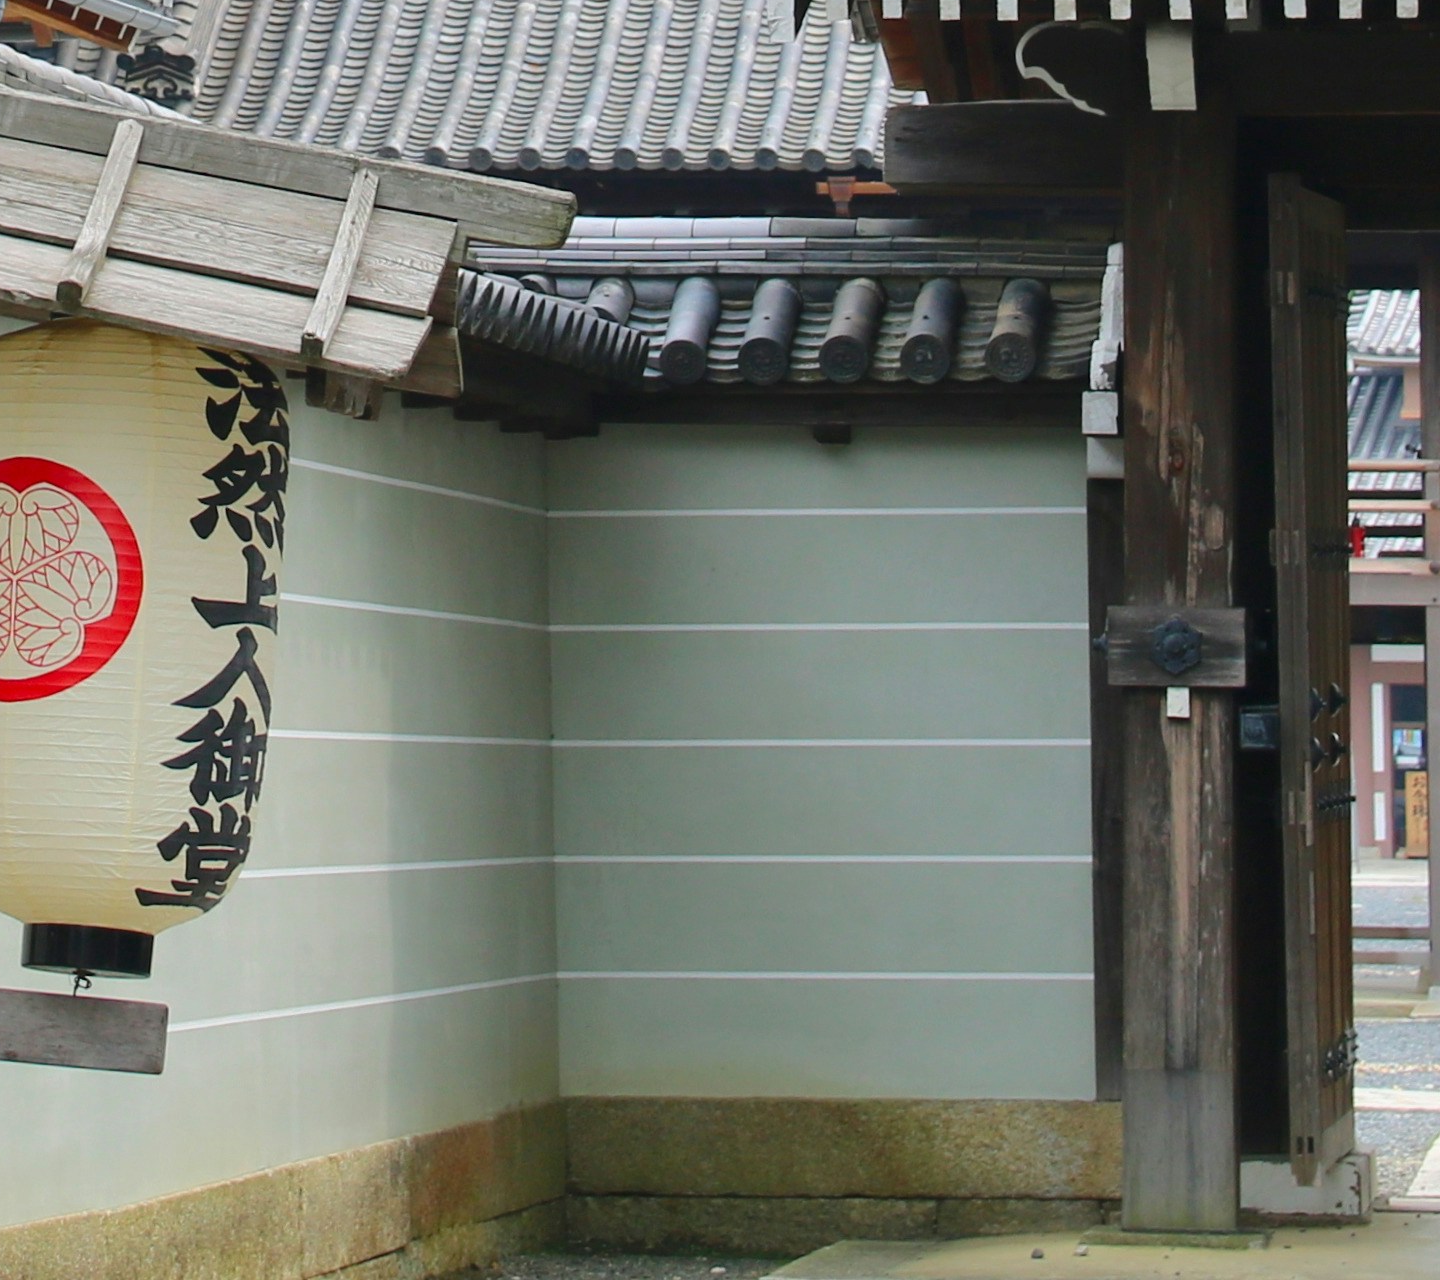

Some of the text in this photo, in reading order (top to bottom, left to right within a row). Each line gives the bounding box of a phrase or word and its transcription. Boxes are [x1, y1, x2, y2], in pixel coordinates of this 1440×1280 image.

[134, 345, 291, 914] 法然上人御堂
